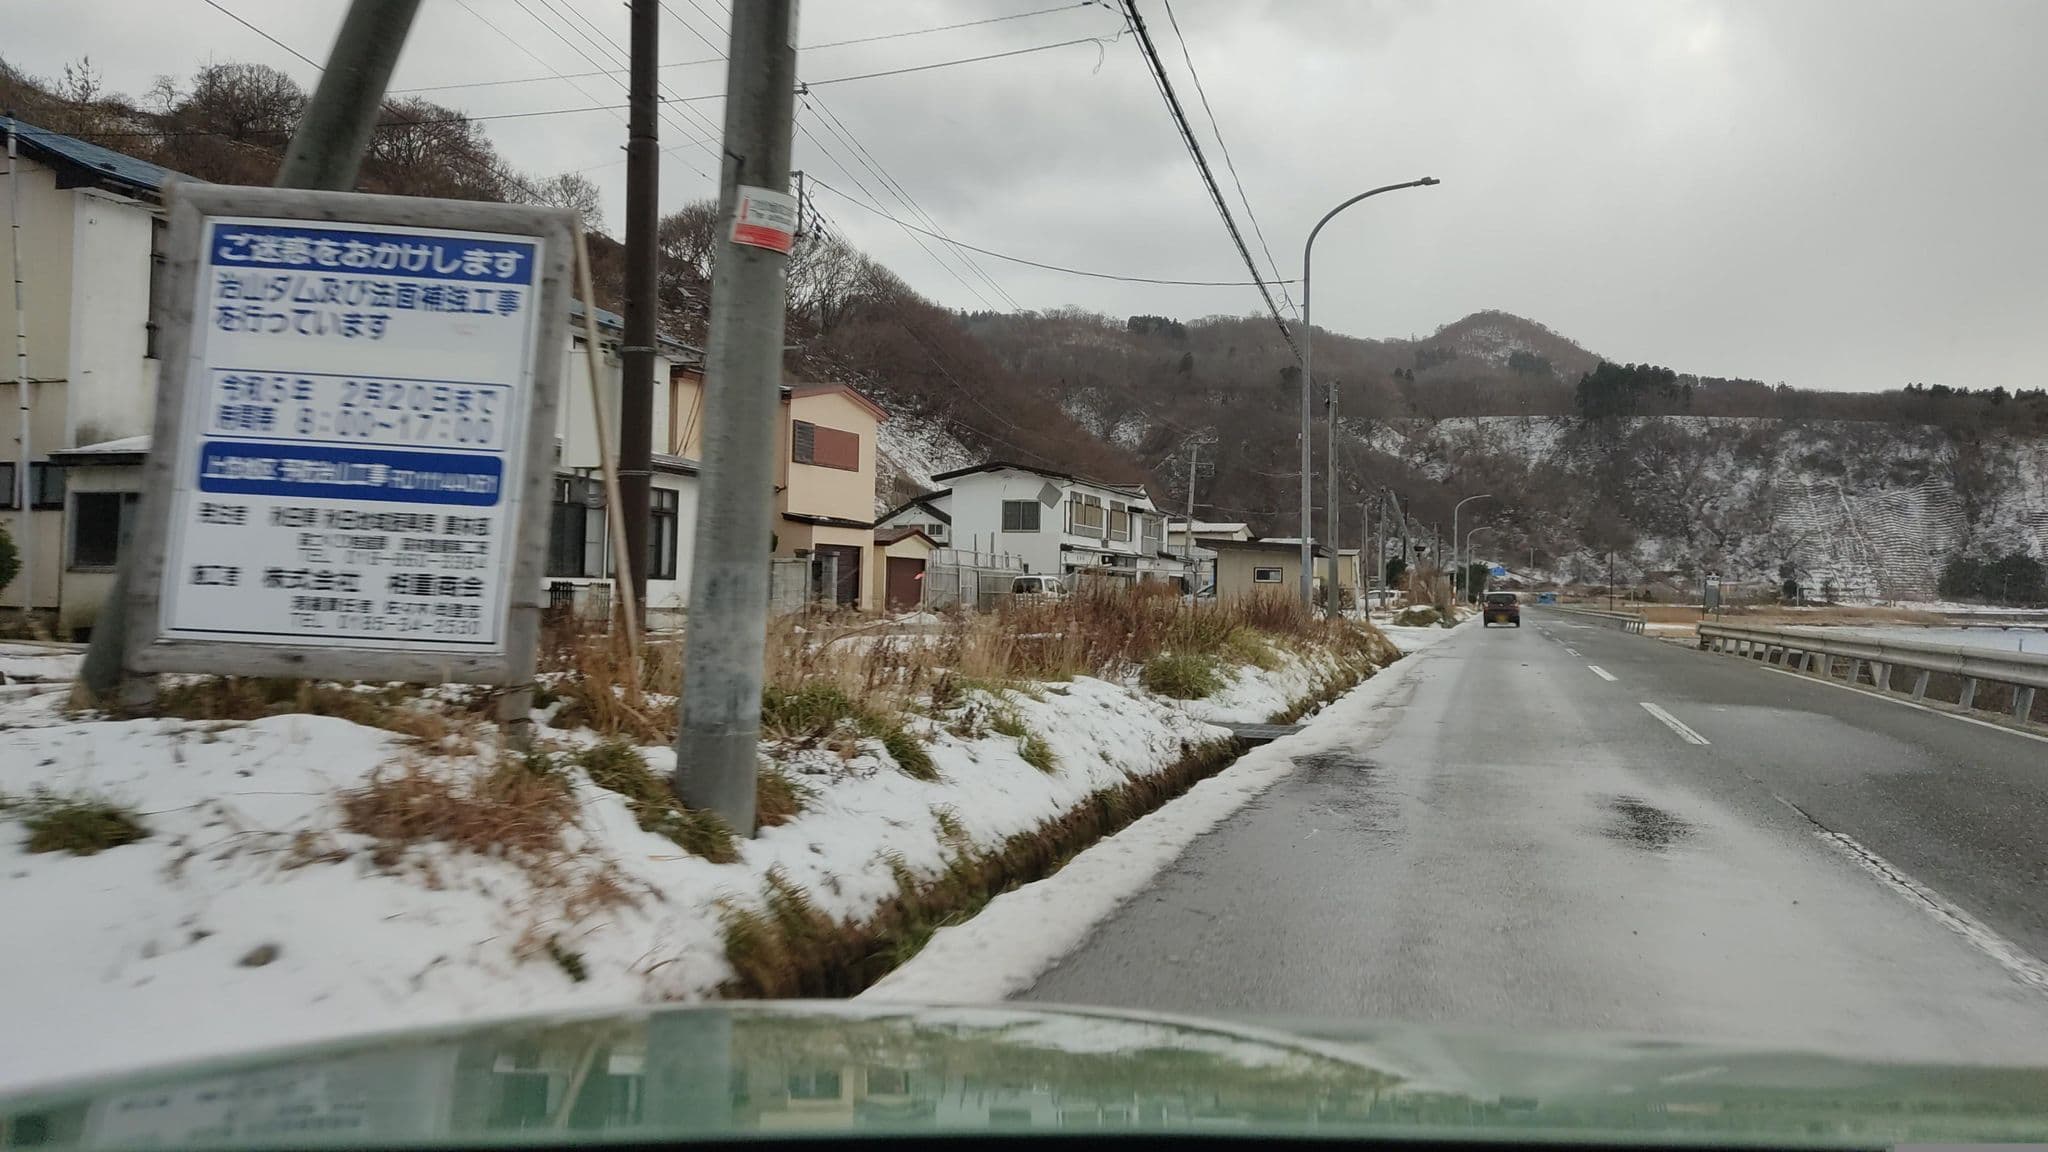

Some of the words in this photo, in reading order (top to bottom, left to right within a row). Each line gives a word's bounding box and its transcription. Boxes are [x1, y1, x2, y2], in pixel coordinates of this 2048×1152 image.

[221, 233, 523, 276] ご迷惑をおかけします
[214, 305, 390, 338] を行っています
